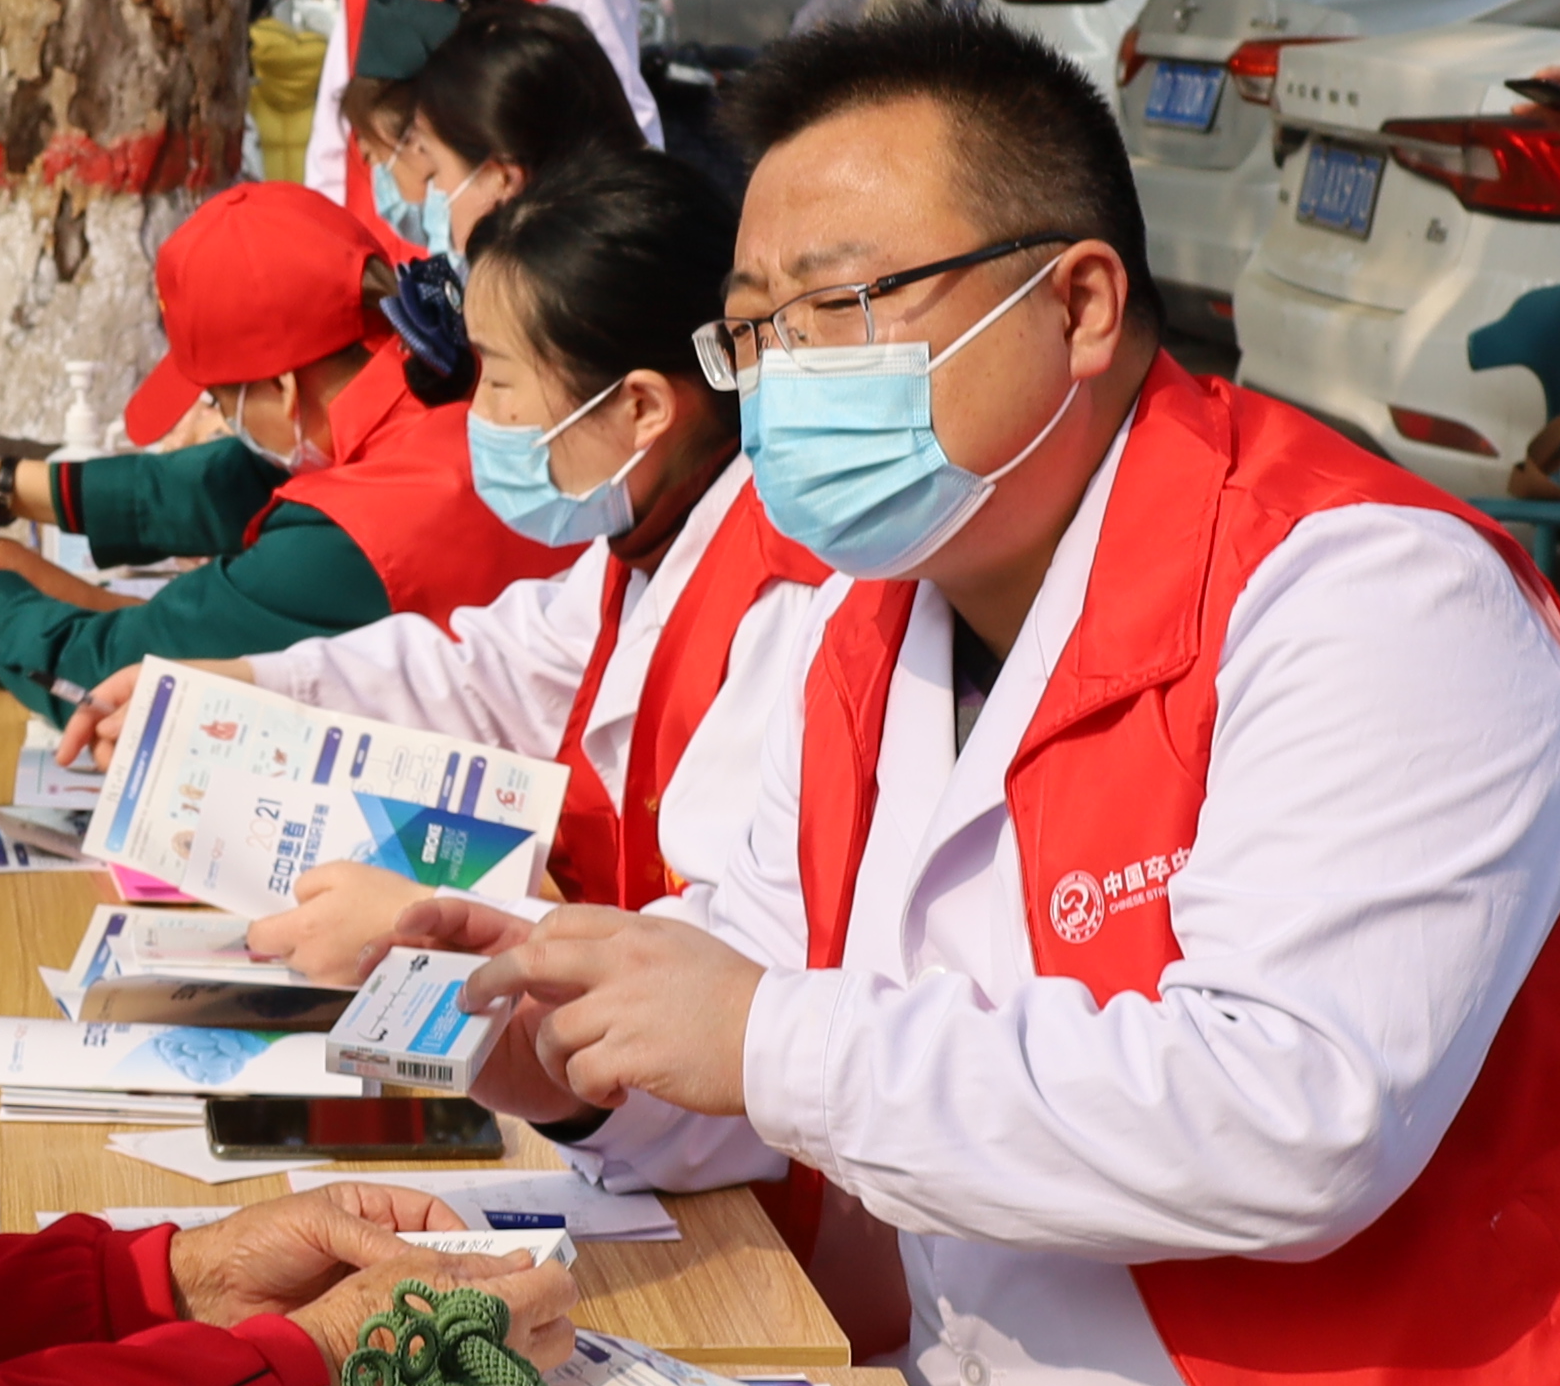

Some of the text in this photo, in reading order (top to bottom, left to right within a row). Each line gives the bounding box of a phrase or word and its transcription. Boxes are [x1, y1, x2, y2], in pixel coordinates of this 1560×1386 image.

[245, 795, 282, 851] 2021
[420, 821, 443, 864] STROKE
[267, 819, 306, 896] 卒中患者
